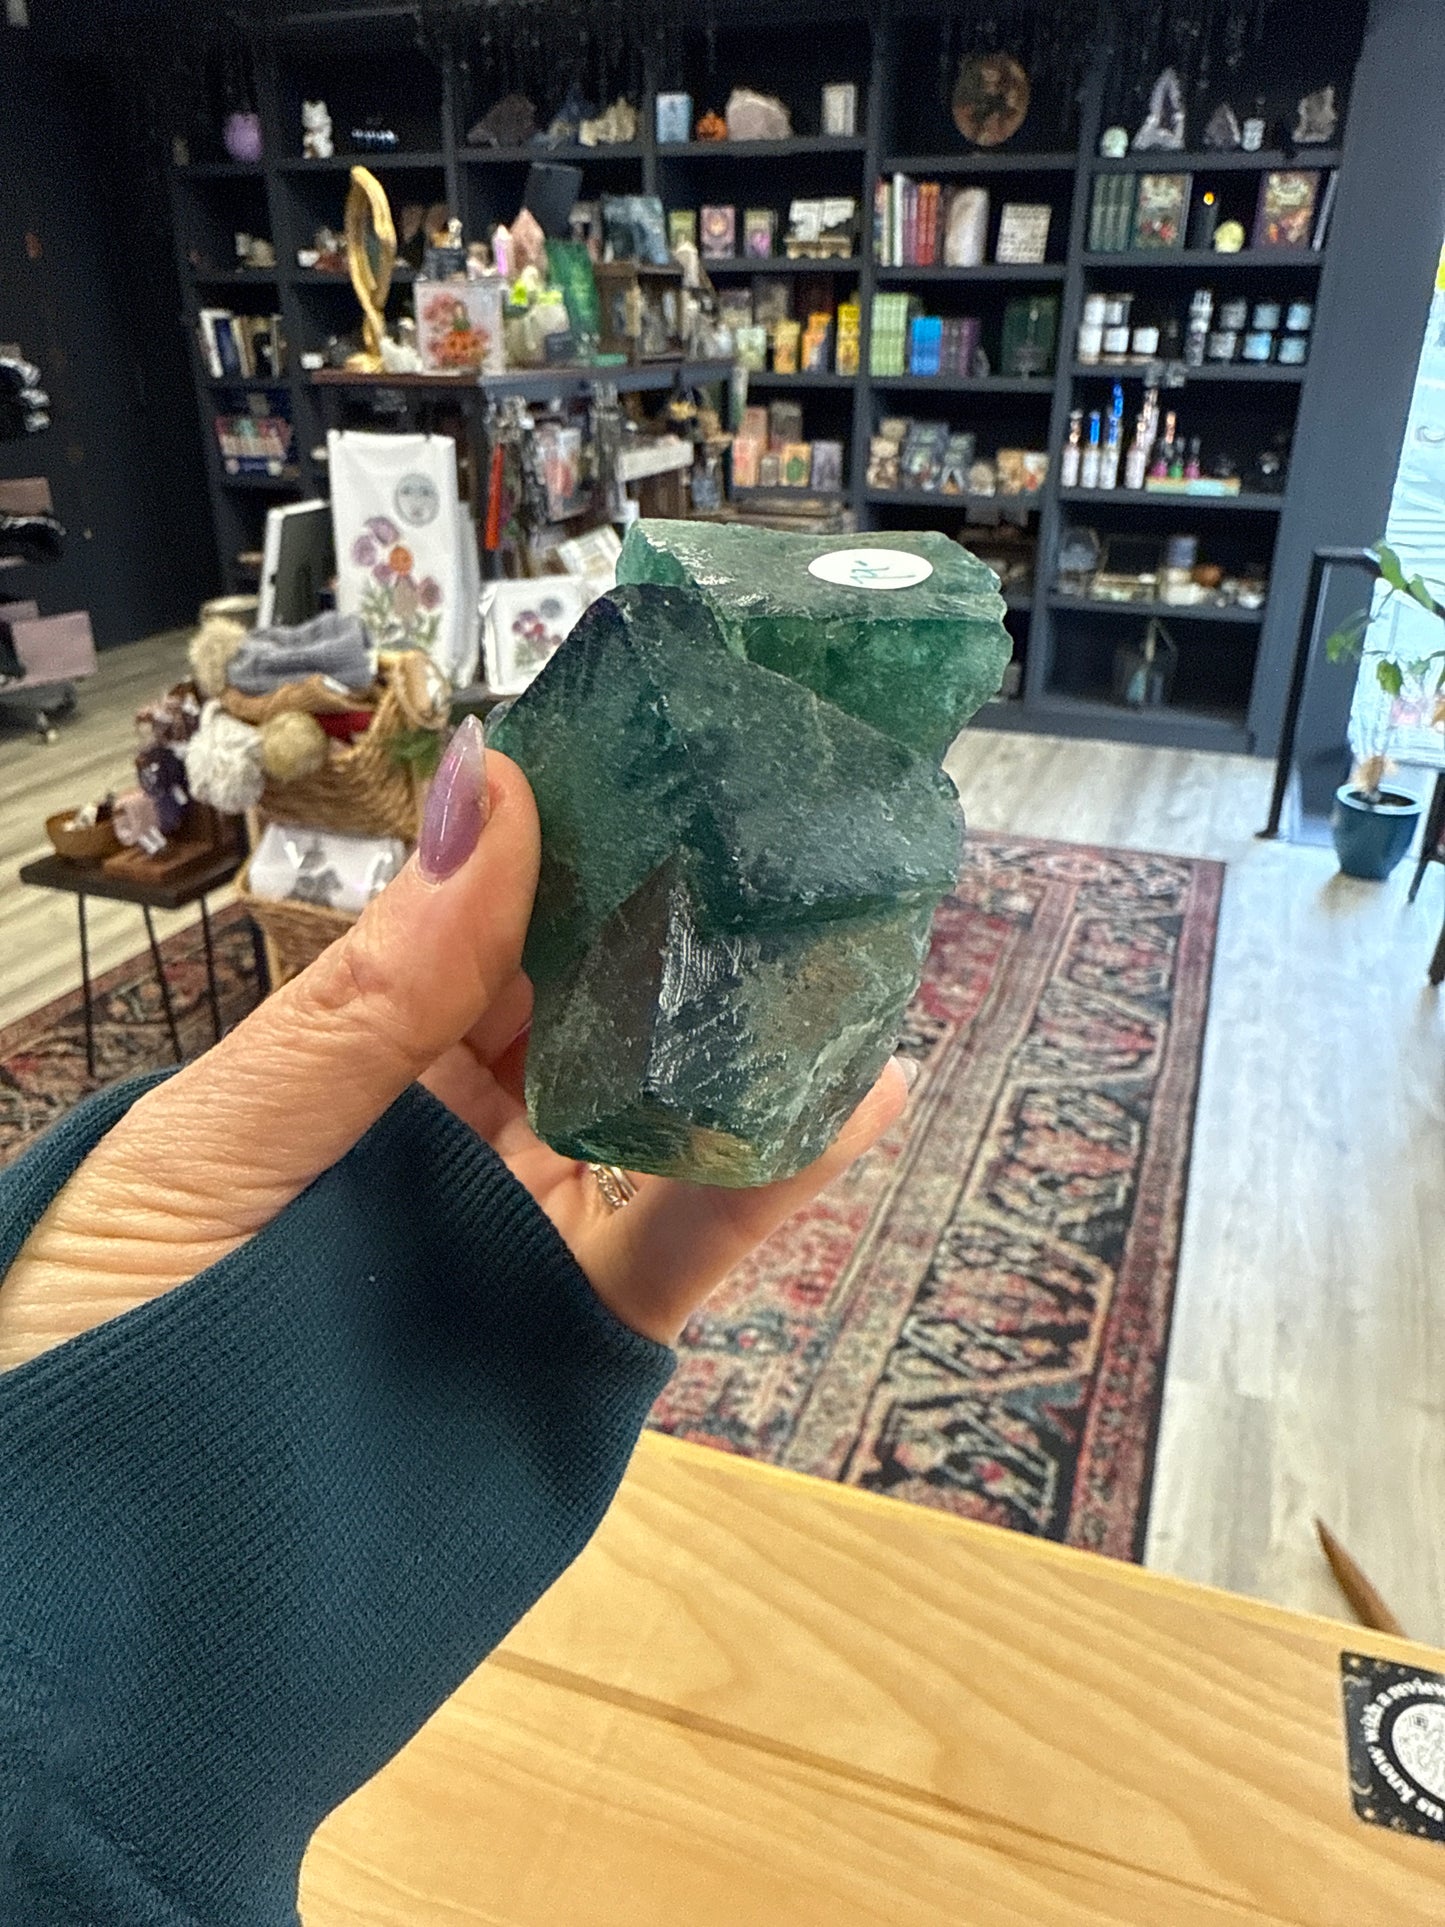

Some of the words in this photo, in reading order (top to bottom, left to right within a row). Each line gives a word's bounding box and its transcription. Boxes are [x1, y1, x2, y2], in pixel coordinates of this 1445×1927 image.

[1376, 1692, 1393, 1708] a
[1387, 1676, 1445, 1700] review
[1360, 1703, 1385, 1743] with
[1368, 1744, 1417, 1804] know
[1416, 1797, 1444, 1822] us
